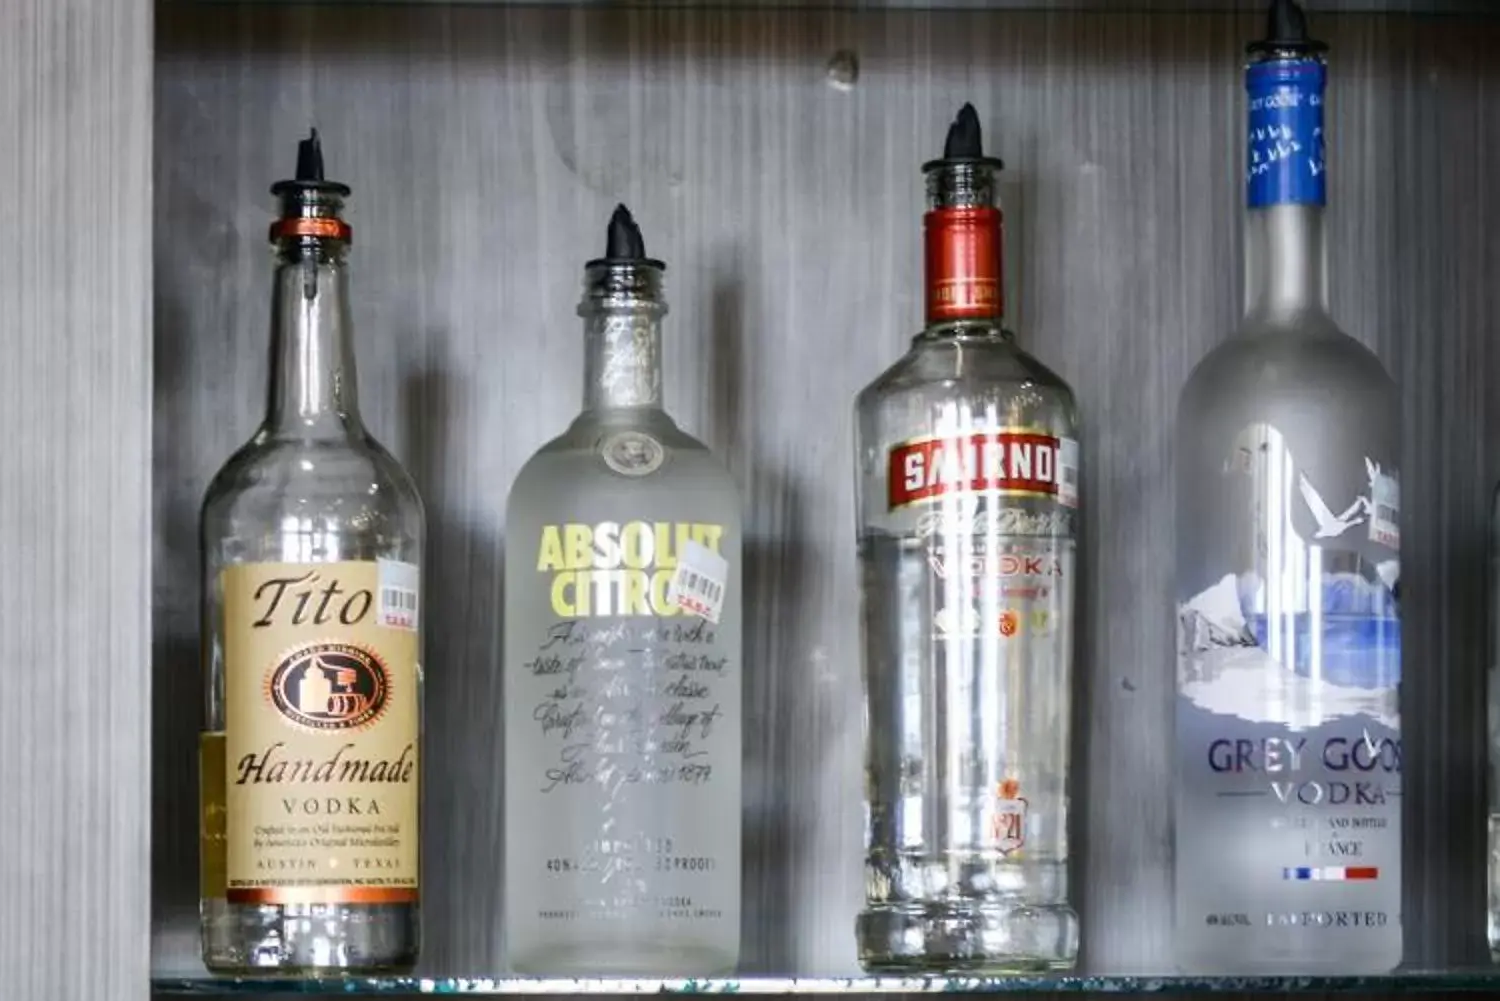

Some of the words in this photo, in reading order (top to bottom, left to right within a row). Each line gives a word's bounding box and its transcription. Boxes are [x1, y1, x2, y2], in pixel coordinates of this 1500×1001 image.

[905, 442, 1058, 491] SMIRNO
[536, 520, 724, 572] ABSOLUT
[252, 570, 373, 628] Tito
[551, 569, 697, 618] CITRO
[236, 743, 414, 785] Handmade
[1208, 737, 1307, 773] GREY
[1323, 736, 1403, 773] GOO
[283, 798, 381, 815] VODKA
[1271, 780, 1387, 806] VODKA
